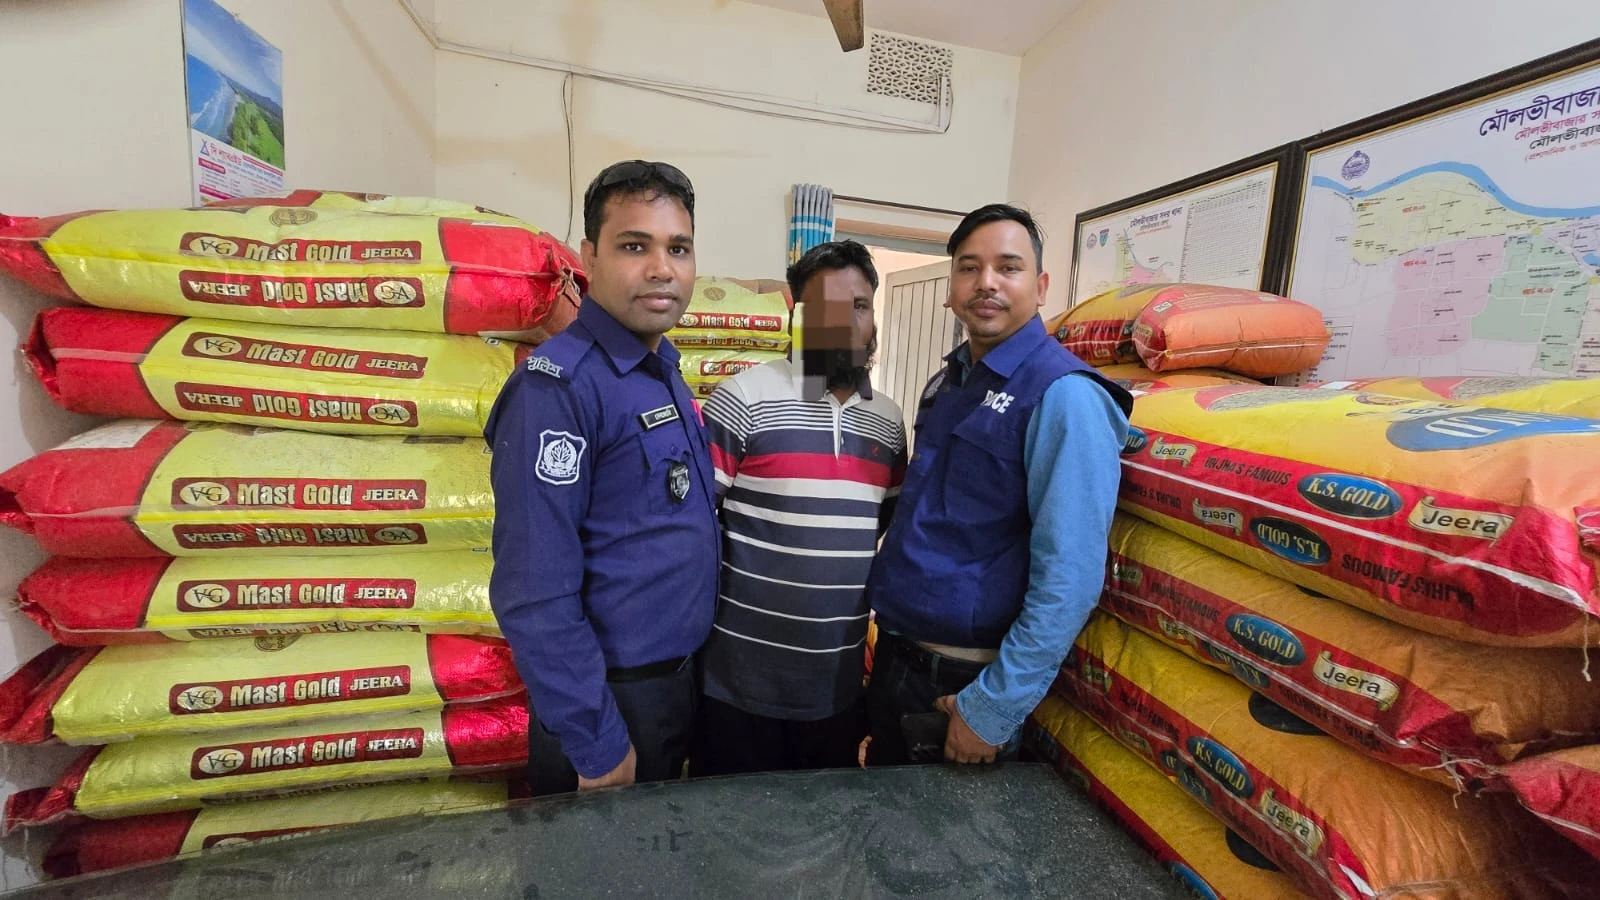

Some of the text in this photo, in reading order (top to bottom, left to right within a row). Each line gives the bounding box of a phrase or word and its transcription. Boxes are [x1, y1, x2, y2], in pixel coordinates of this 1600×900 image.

[306, 244, 352, 263] Gold
[361, 247, 414, 259] JEERA
[187, 280, 251, 297] JEERA
[260, 281, 308, 303] Gold
[315, 282, 369, 304] Mast
[246, 343, 305, 364] Mast
[311, 351, 359, 369] Gold
[365, 358, 418, 372] JEERA
[526, 356, 563, 378] পুলিশ
[183, 391, 244, 408] JEERA
[253, 394, 301, 414] Gold
[308, 398, 362, 420] Mast
[1155, 444, 1186, 457] Jeera
[1245, 466, 1292, 486] FAMOUS
[237, 483, 296, 505] Mast
[303, 484, 353, 505] Gold
[362, 488, 418, 501] JEERA
[1306, 477, 1390, 511] K.S. GOLD
[1201, 508, 1236, 524] Jeera
[1422, 509, 1500, 533] Jeera
[1257, 523, 1290, 549] GOLD
[1341, 553, 1410, 588] FAMOUS
[237, 583, 292, 606] Mast
[299, 583, 346, 605] Gold
[354, 587, 407, 600] JEERA
[1234, 618, 1297, 660] K.S. GOLD
[230, 684, 287, 707] Mast
[294, 676, 340, 698] Gold
[350, 675, 403, 691] JEERA
[1323, 666, 1381, 695] Jeera
[250, 742, 305, 769] Mast
[312, 737, 356, 761] Gold
[366, 737, 416, 752] JEERA
[1215, 759, 1247, 792] GOLD
[1267, 805, 1310, 838] Jeera
